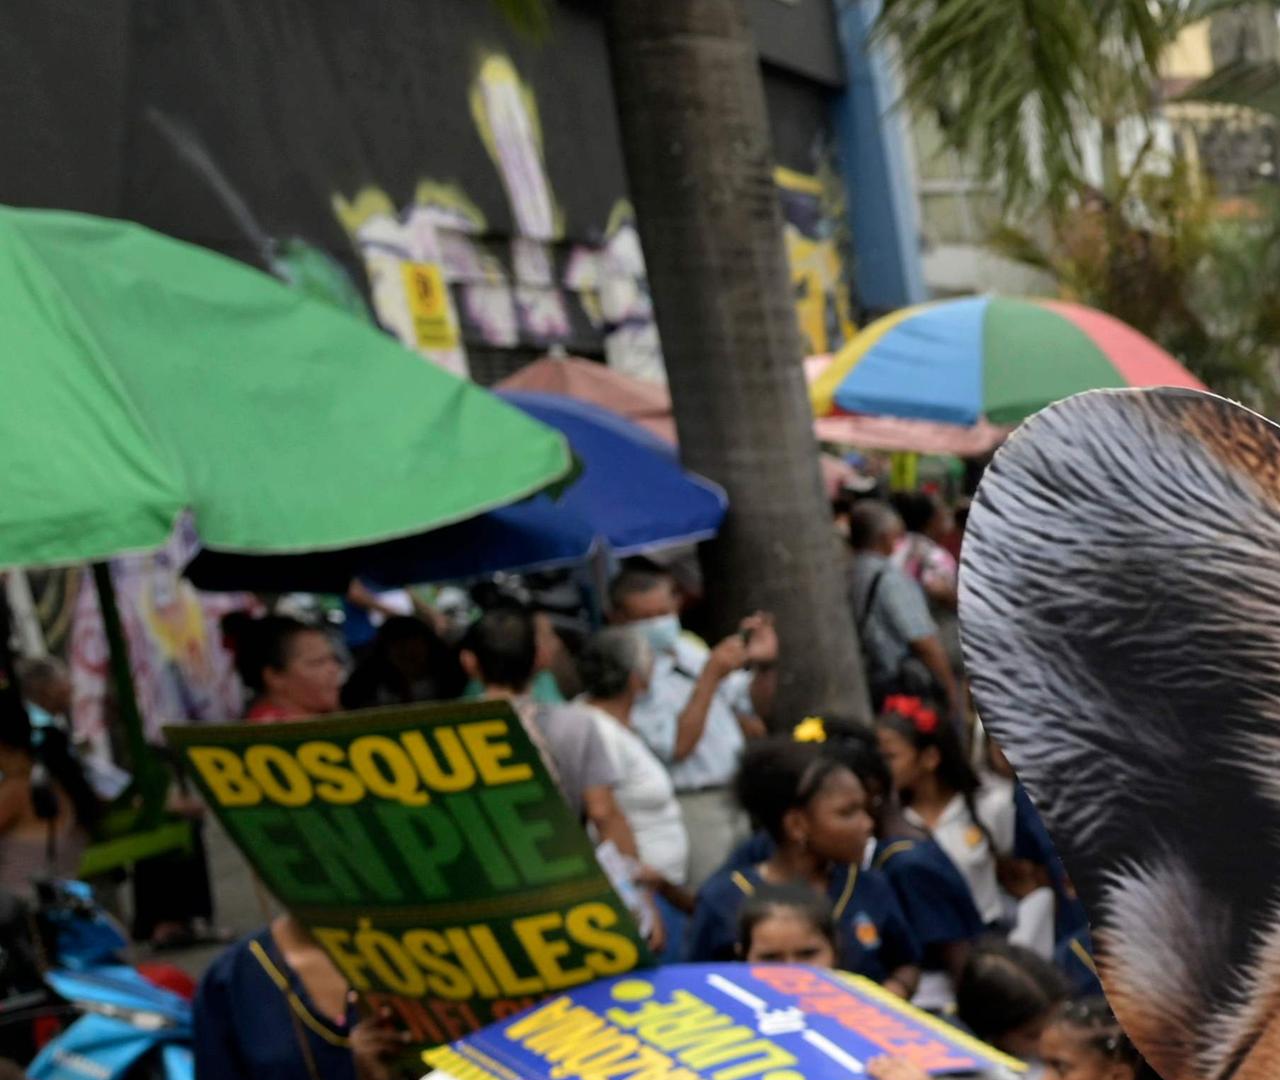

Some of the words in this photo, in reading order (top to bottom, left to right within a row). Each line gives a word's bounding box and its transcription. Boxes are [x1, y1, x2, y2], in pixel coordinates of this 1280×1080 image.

[188, 720, 533, 805] BOSQUE
[229, 805, 386, 899] EN
[375, 781, 590, 898] PIE
[312, 903, 639, 998] FÓSILES
